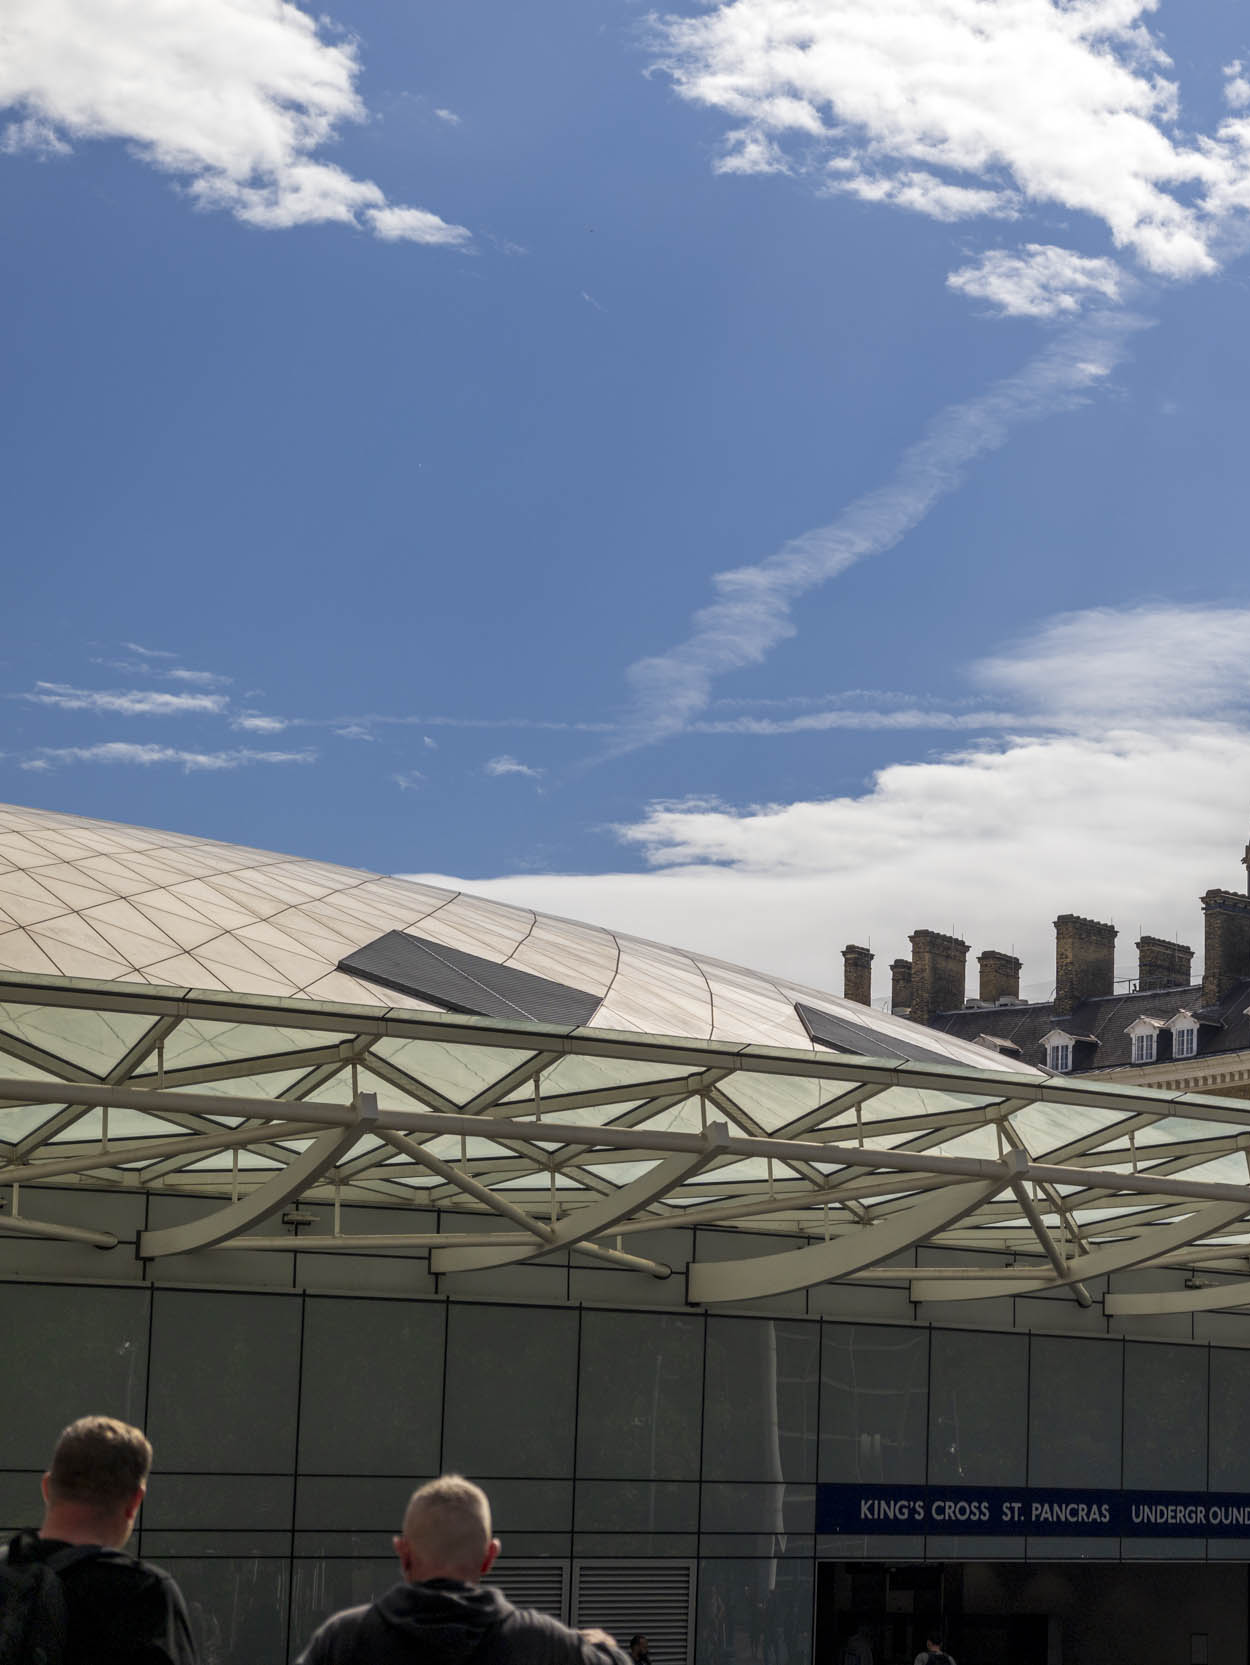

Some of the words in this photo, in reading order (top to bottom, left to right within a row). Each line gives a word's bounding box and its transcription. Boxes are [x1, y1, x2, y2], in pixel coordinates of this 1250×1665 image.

[860, 1499, 924, 1520] KING'S
[931, 1501, 989, 1521] CROSS
[1001, 1503, 1025, 1521] ST.
[1031, 1504, 1110, 1522] PANCRAS
